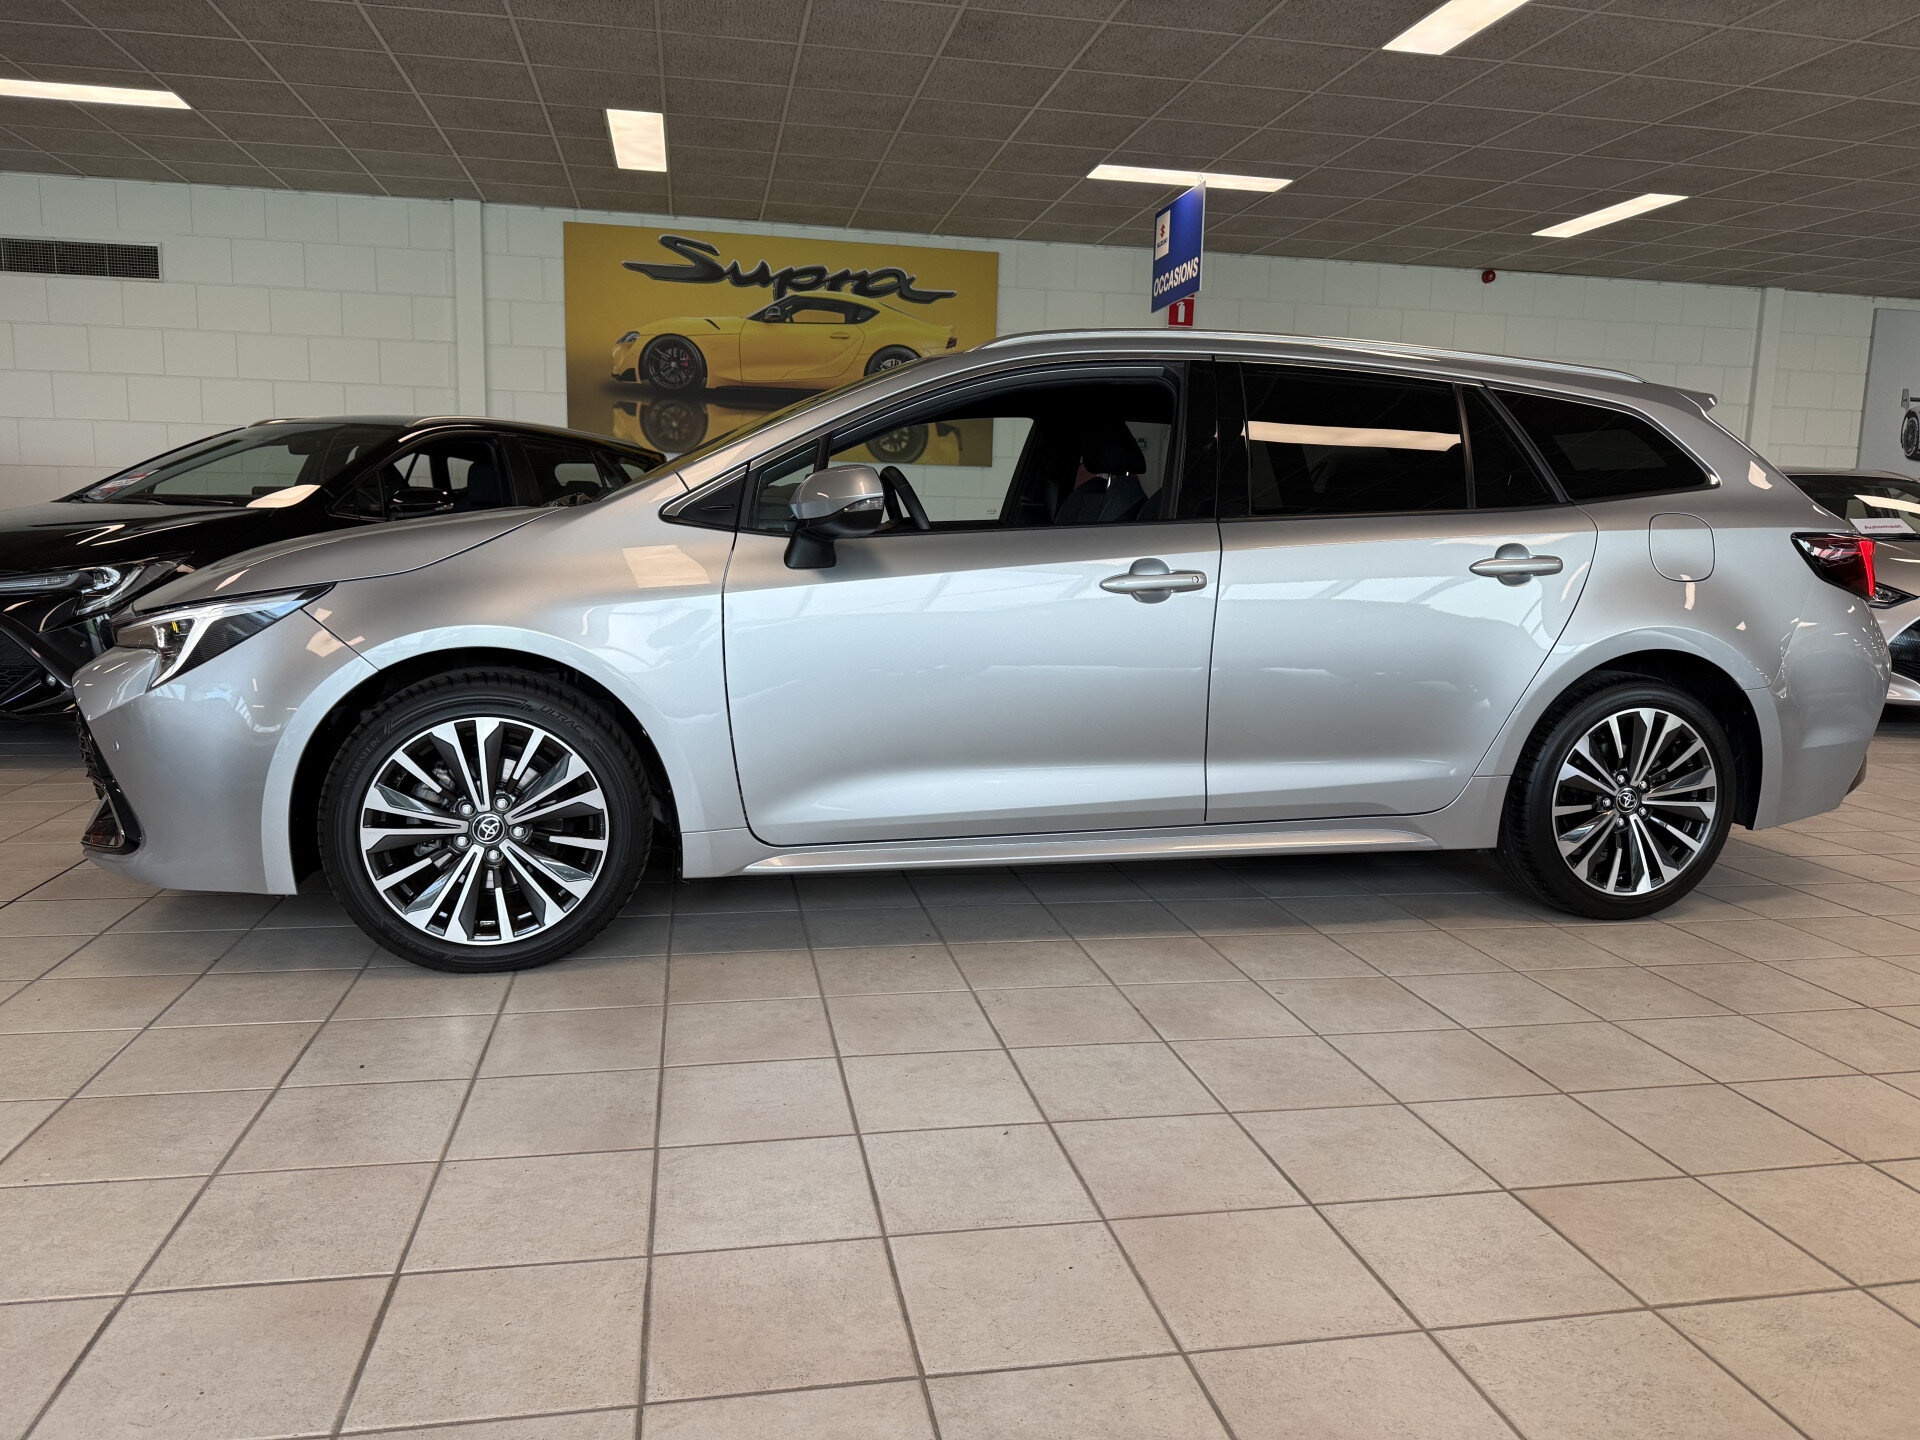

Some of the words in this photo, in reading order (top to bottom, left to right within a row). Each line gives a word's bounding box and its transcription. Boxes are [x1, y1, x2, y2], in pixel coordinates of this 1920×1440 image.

[622, 235, 957, 304] Supra
[1153, 256, 1199, 297] OCCASIONS
[540, 706, 584, 734] ULTRAC
